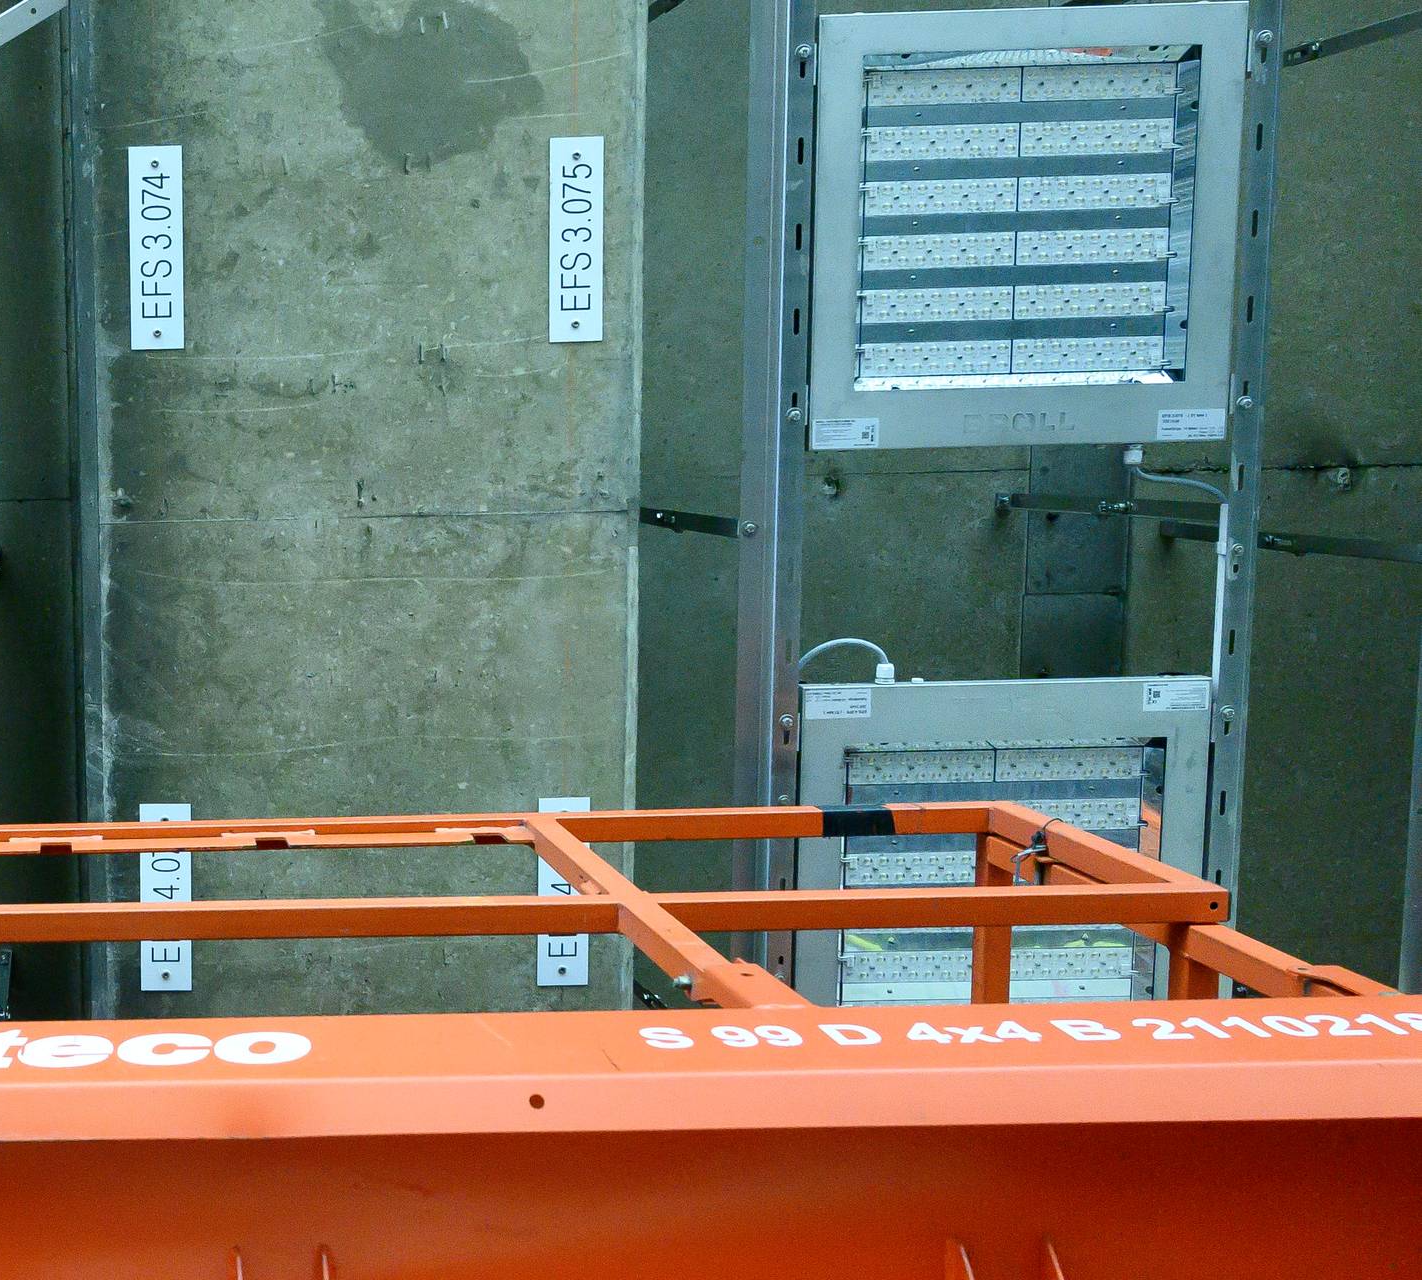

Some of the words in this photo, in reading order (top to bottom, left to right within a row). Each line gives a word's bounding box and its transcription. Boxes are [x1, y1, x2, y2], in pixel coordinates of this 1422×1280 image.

[140, 172, 173, 250] 3.074
[561, 163, 593, 243] 3.075
[140, 259, 173, 319] EFS
[560, 252, 592, 312] EFS
[638, 1026, 695, 1050] S
[710, 1024, 804, 1048] 99
[817, 1023, 883, 1047] D
[906, 1021, 1043, 1044] 4x4
[1049, 1019, 1122, 1041] B
